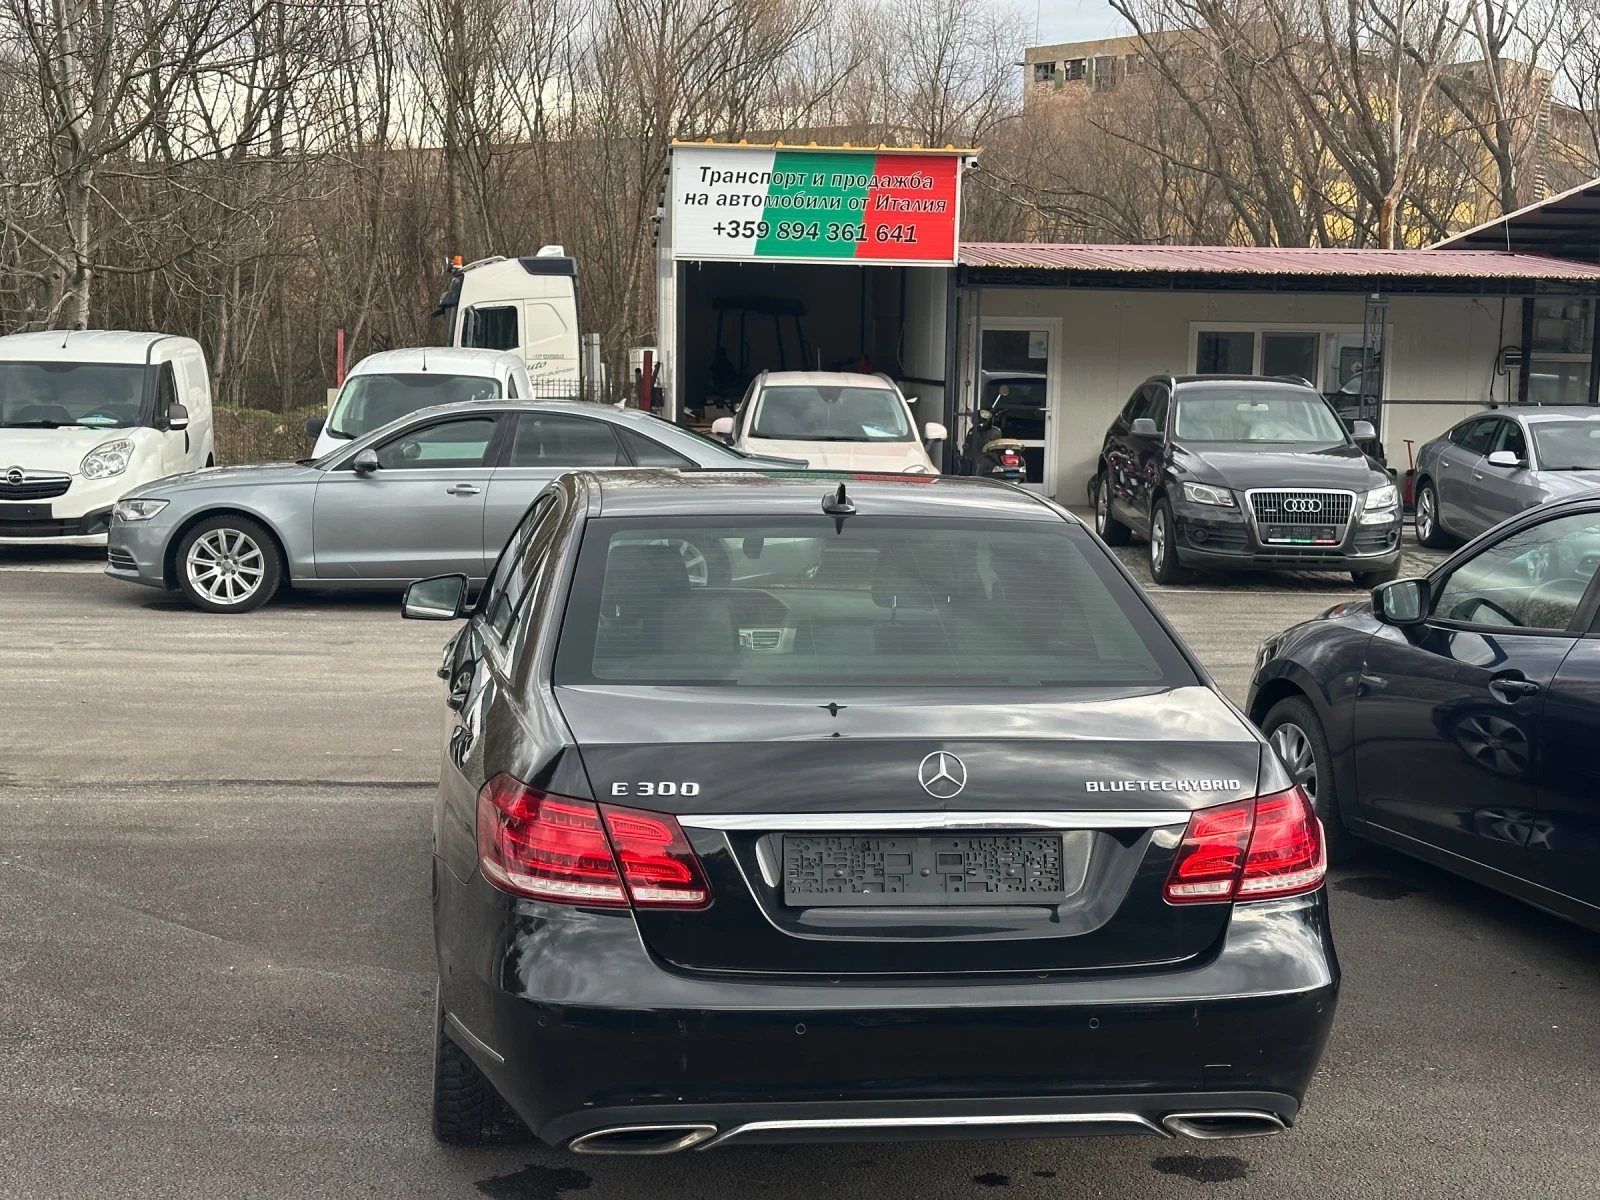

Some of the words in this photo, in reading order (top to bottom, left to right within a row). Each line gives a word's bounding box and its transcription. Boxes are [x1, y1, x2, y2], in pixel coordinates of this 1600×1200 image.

[699, 166, 807, 187] Транспорт
[812, 173, 825, 186] и
[831, 170, 934, 191] продажба
[684, 192, 709, 206] на
[715, 191, 841, 211] автомобили
[849, 197, 871, 211] от
[874, 195, 947, 213] Италия
[712, 220, 770, 239] +359
[776, 221, 819, 241] 894
[826, 222, 868, 242] 361
[875, 224, 918, 243] 641
[611, 782, 629, 796] E
[636, 781, 700, 797] 300
[1085, 780, 1174, 793] BLUETEC
[1176, 779, 1241, 792] HYBRID
